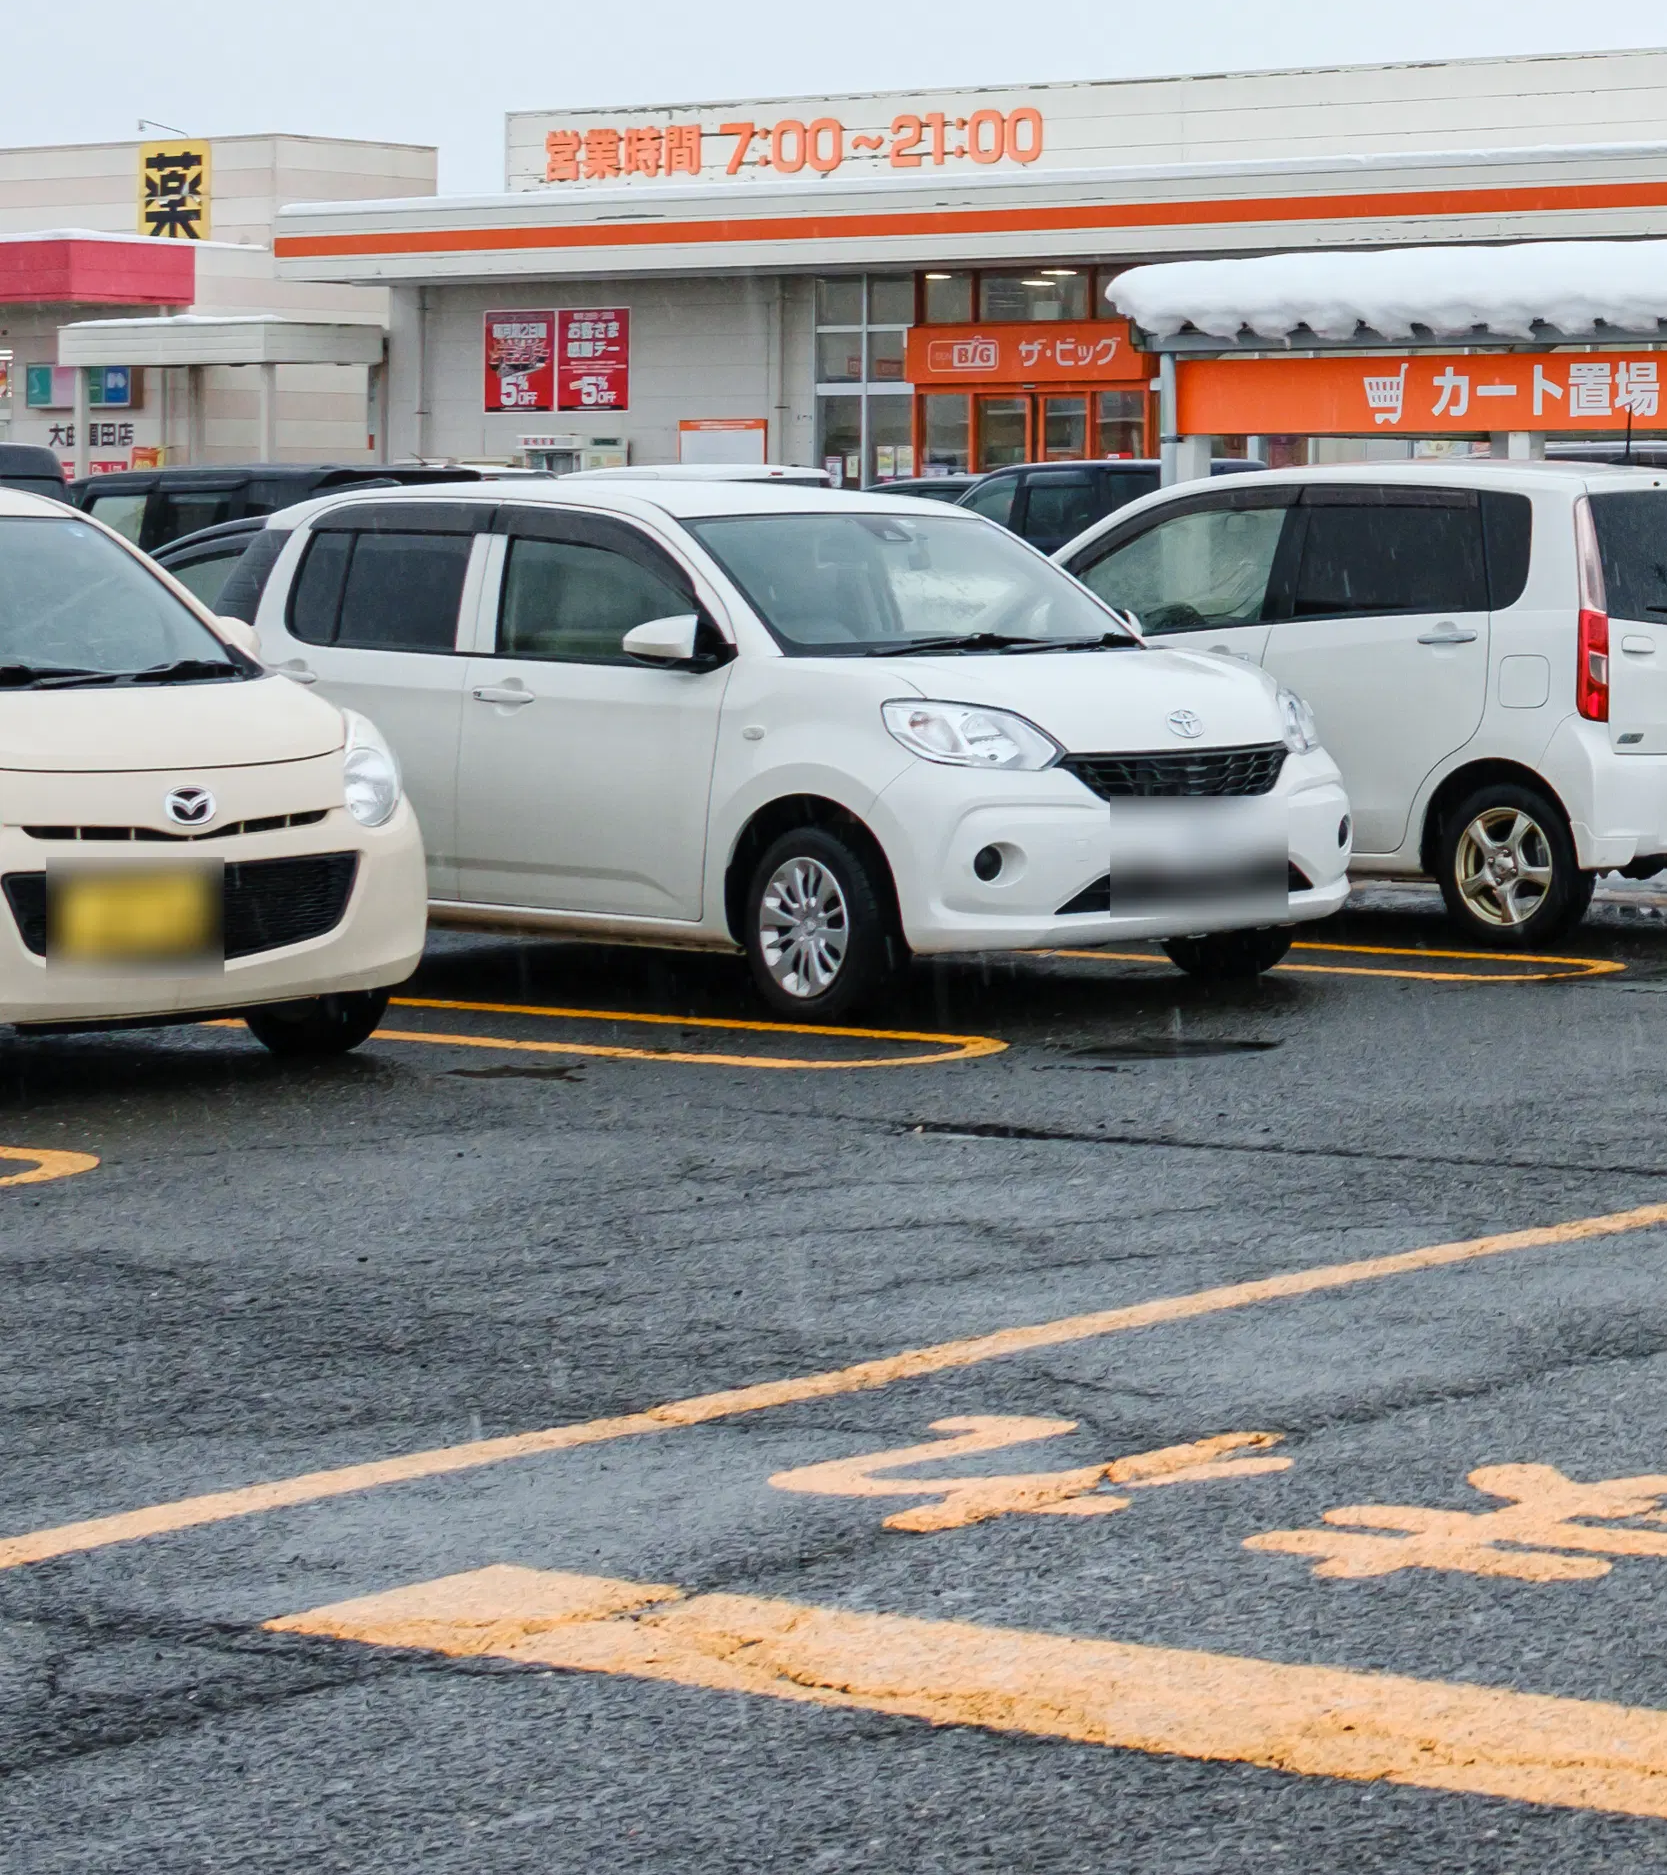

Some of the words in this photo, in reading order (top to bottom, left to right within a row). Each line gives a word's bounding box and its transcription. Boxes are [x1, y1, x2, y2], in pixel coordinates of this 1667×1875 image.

[545, 125, 701, 182] 営業時間
[145, 151, 203, 238] 薬
[1019, 337, 1121, 366] ザ・ビッグ
[518, 392, 538, 405] OFF
[597, 391, 617, 403] OFF
[1431, 362, 1659, 417] カート置場
